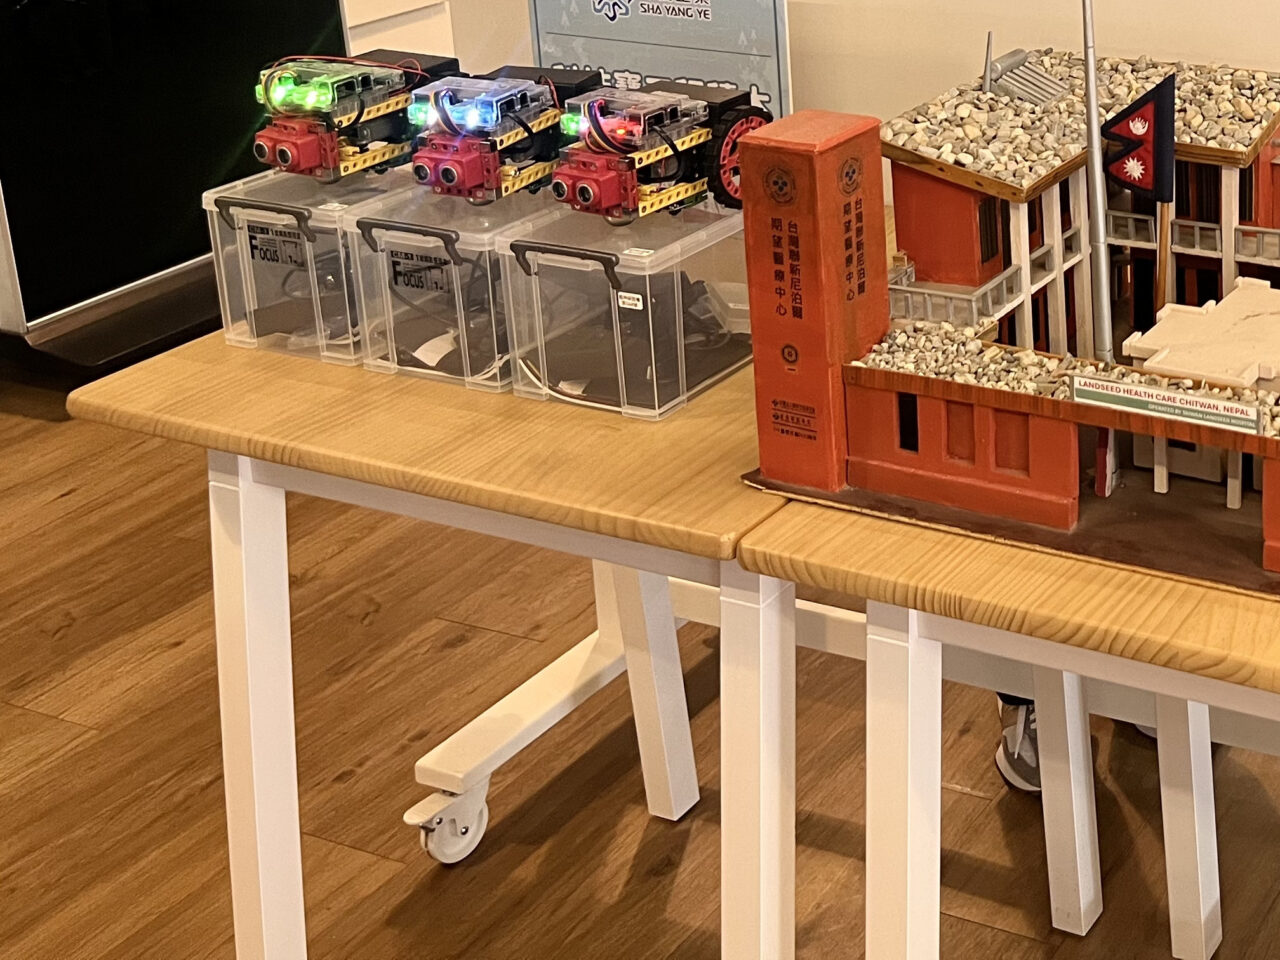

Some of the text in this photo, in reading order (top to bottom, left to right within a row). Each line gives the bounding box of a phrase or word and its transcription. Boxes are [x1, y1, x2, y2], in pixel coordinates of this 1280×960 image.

[640, 2, 711, 20] SHA YANG YE
[1078, 380, 1122, 394] LANDSEED
[1123, 387, 1154, 399] HEALTH
[1155, 394, 1177, 404] CARE
[1223, 405, 1251, 417] NEPAL
